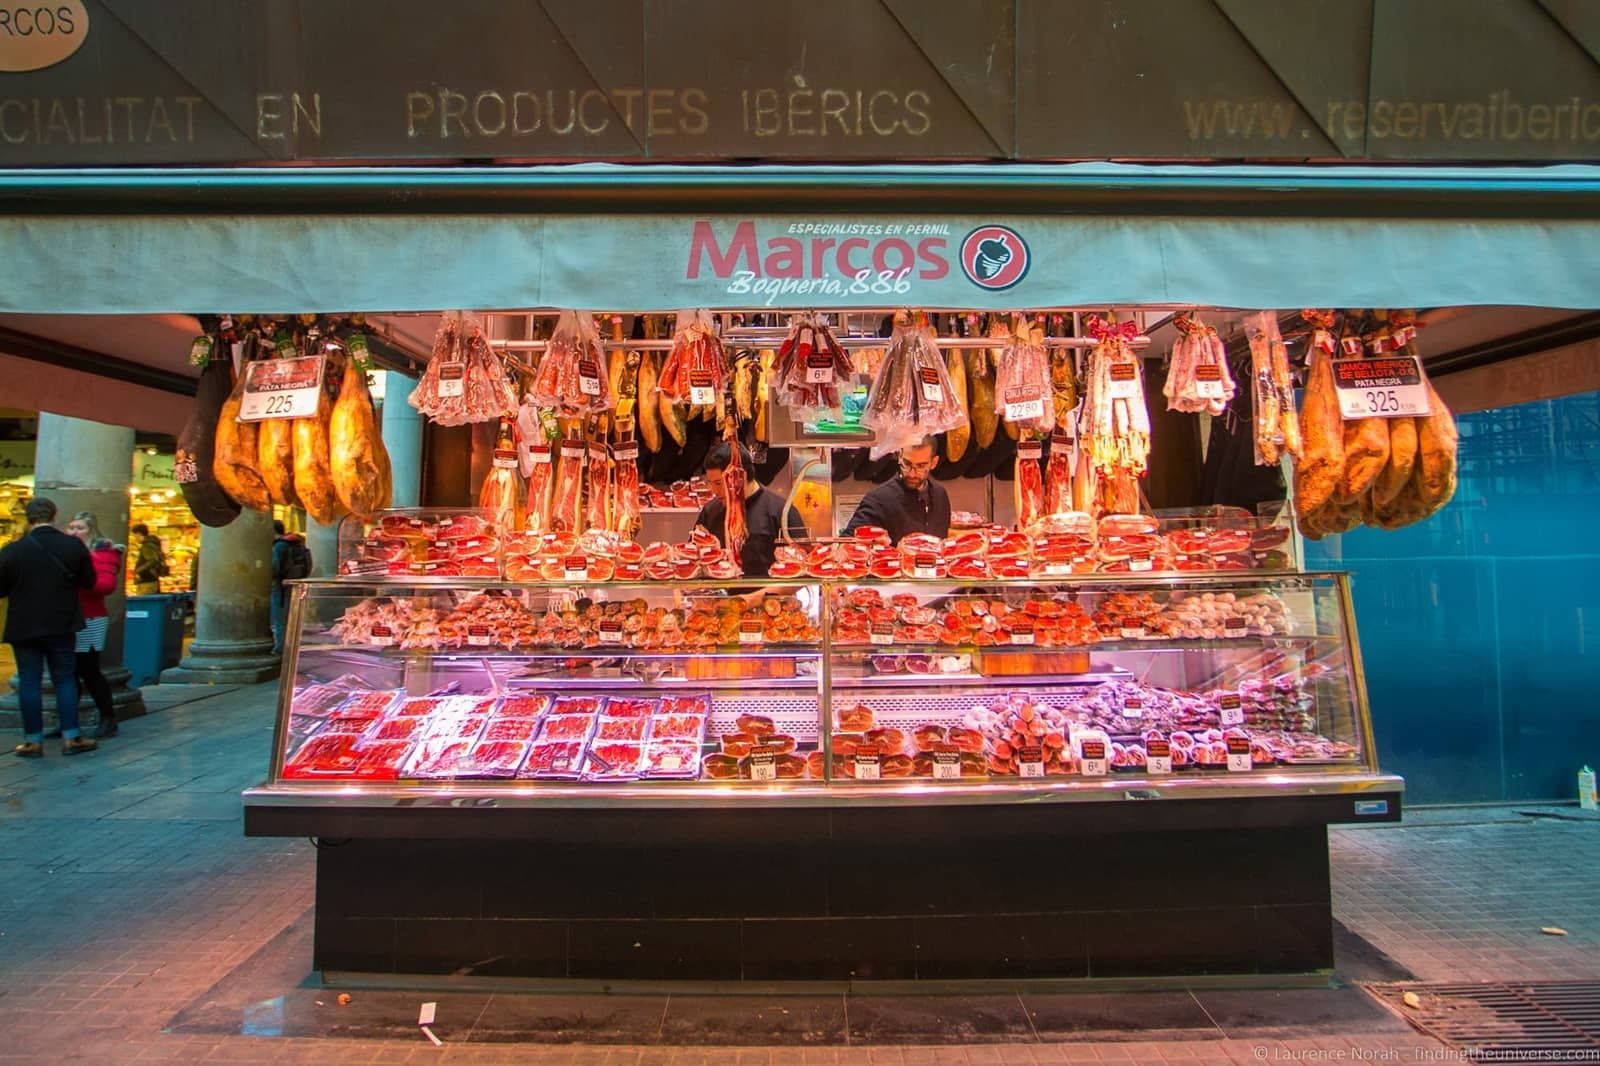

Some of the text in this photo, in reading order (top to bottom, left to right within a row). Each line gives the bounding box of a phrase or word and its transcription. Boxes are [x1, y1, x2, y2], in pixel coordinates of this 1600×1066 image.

[0, 75, 932, 144] CIALITAT EN PRODUCTES IBÈRICS
[788, 223, 951, 236] ESPECIALISTES EN PERNIL
[686, 220, 950, 281] Marcos
[259, 381, 308, 392] PATA NEGRA
[1354, 378, 1402, 388] PATA NEGRA
[266, 394, 294, 414] 225
[1366, 391, 1399, 413] 325
